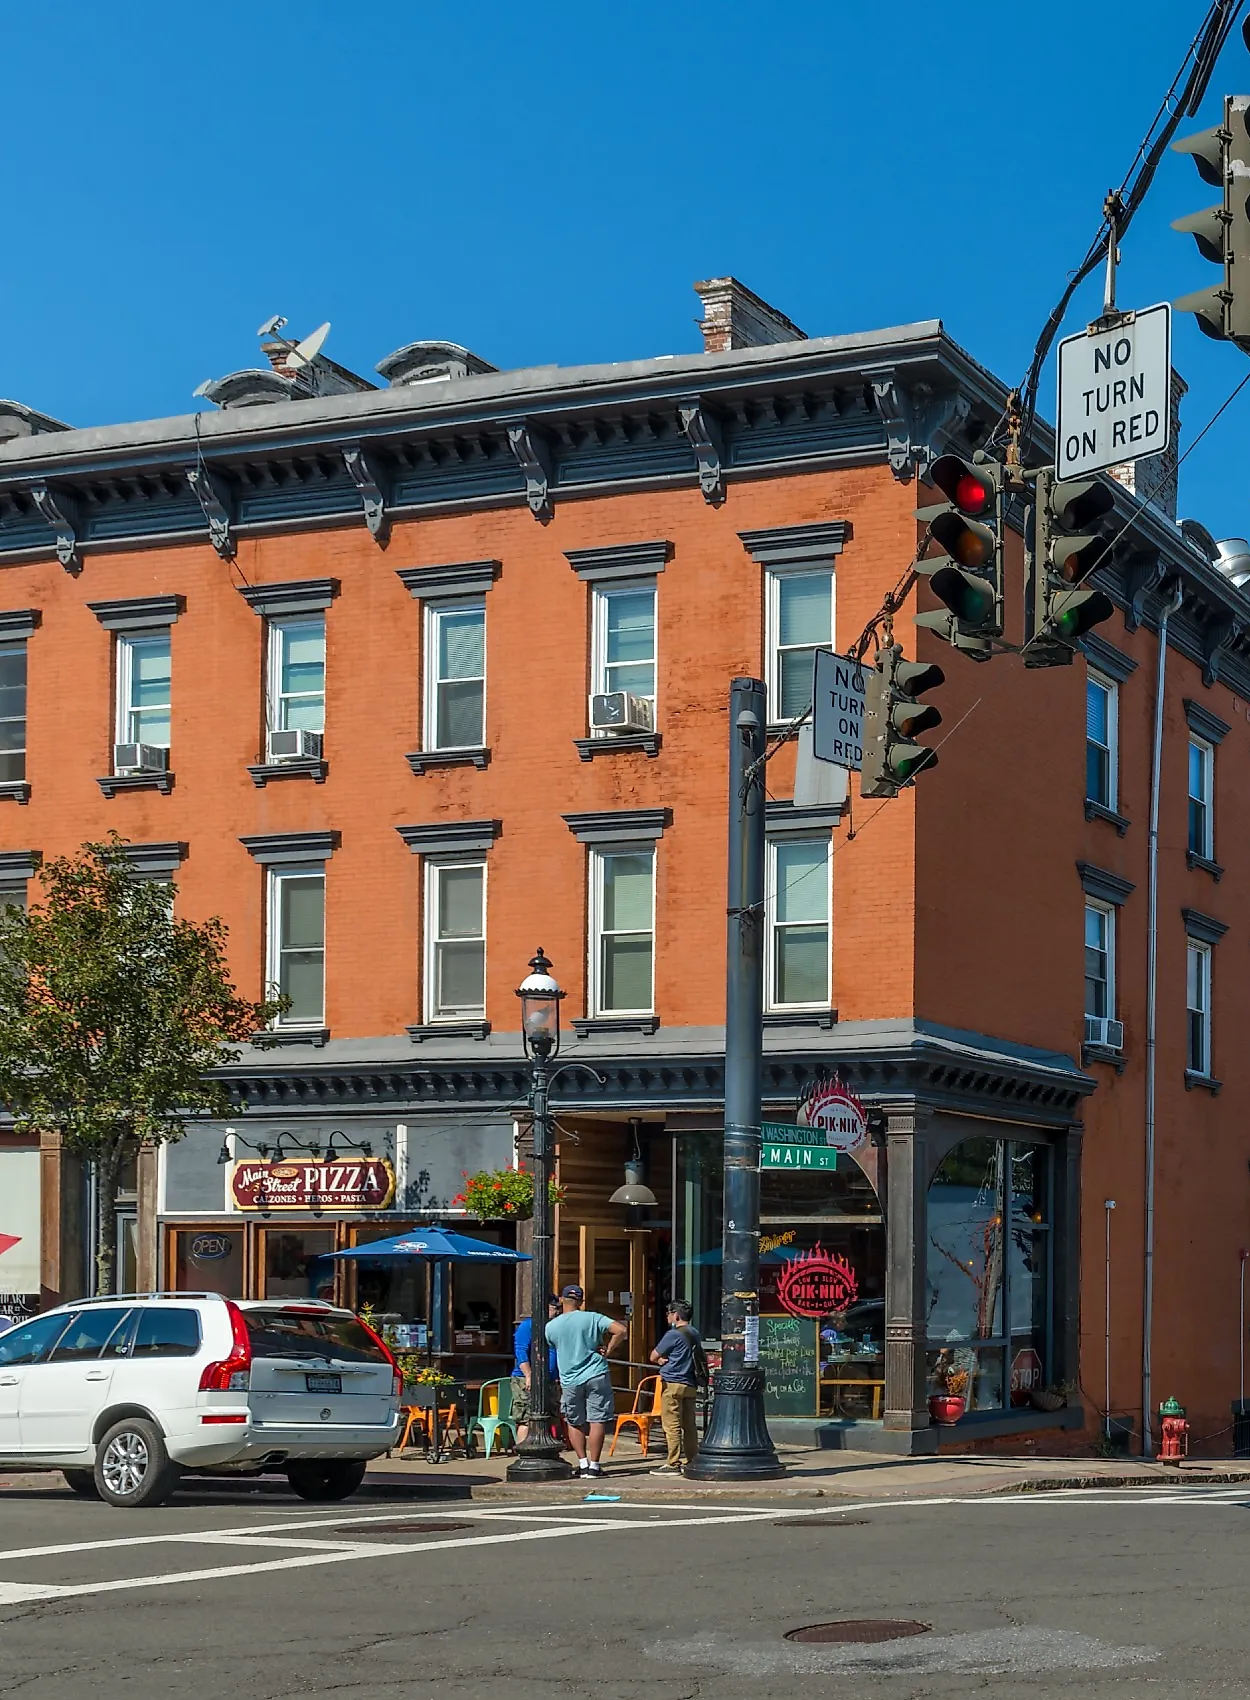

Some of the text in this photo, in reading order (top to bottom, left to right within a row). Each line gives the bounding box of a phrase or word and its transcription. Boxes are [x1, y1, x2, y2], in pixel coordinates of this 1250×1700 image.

[1094, 338, 1132, 374] NO
[1082, 373, 1145, 416] TURN
[1066, 409, 1159, 462] ON RED
[835, 665, 865, 695] NO
[839, 718, 859, 739] ON
[833, 739, 863, 762] RED
[766, 1126, 818, 1145] WASHINGTON
[770, 1148, 829, 1166] MAIN ST
[238, 1166, 380, 1194] Main Street PIZZA
[253, 1194, 367, 1204] CALZONES HEROS PASTA
[192, 1239, 226, 1254] OPEN
[1011, 1368, 1040, 1391] STOP
